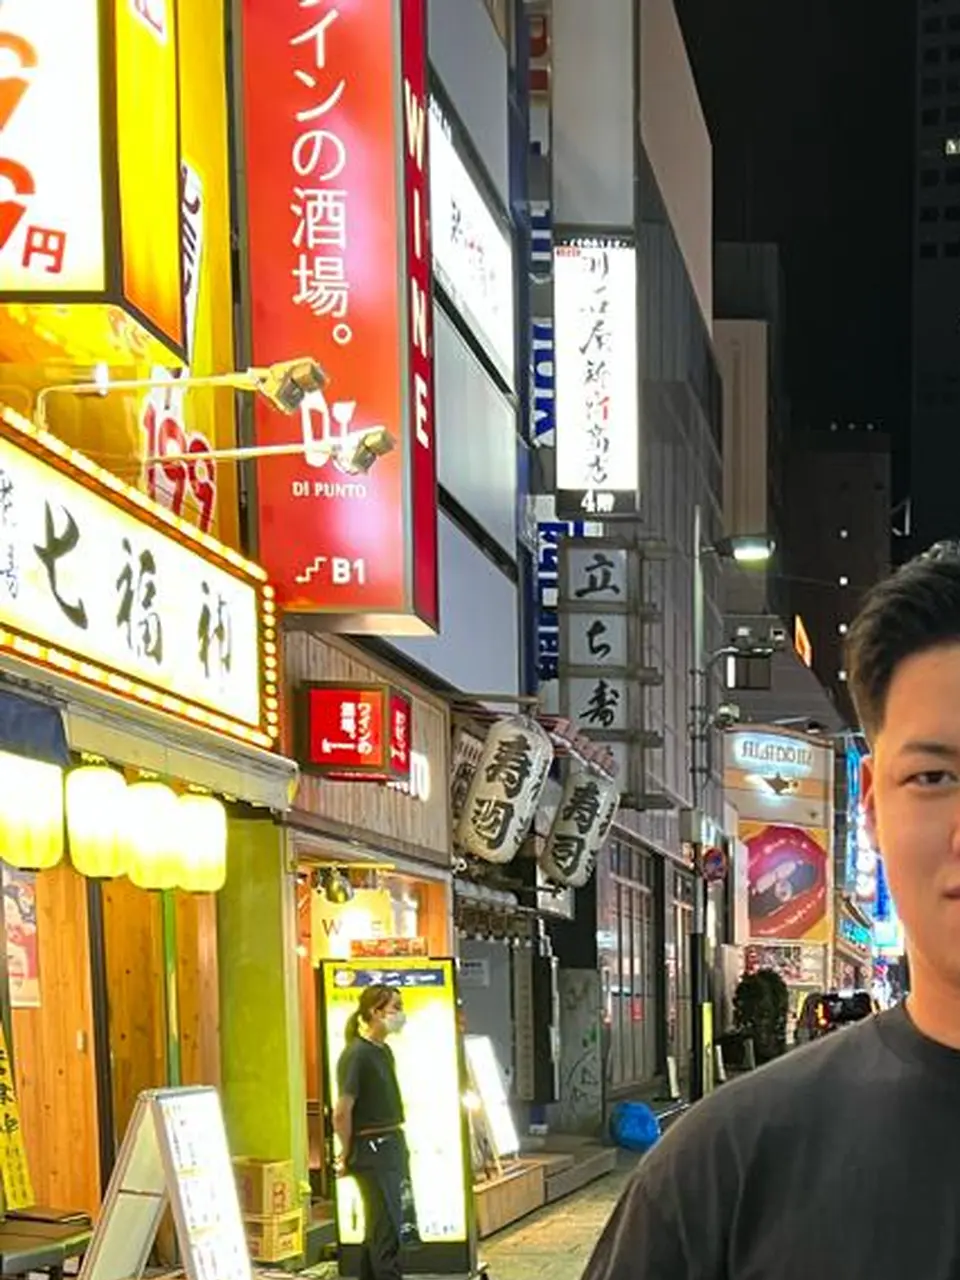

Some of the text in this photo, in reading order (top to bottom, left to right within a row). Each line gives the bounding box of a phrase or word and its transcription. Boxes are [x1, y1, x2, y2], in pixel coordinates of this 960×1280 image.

[289, 0, 353, 345] インの酒場。
[314, 482, 367, 499] PUNTO
[331, 559, 367, 584] B1
[574, 552, 623, 757] 立ち寿
